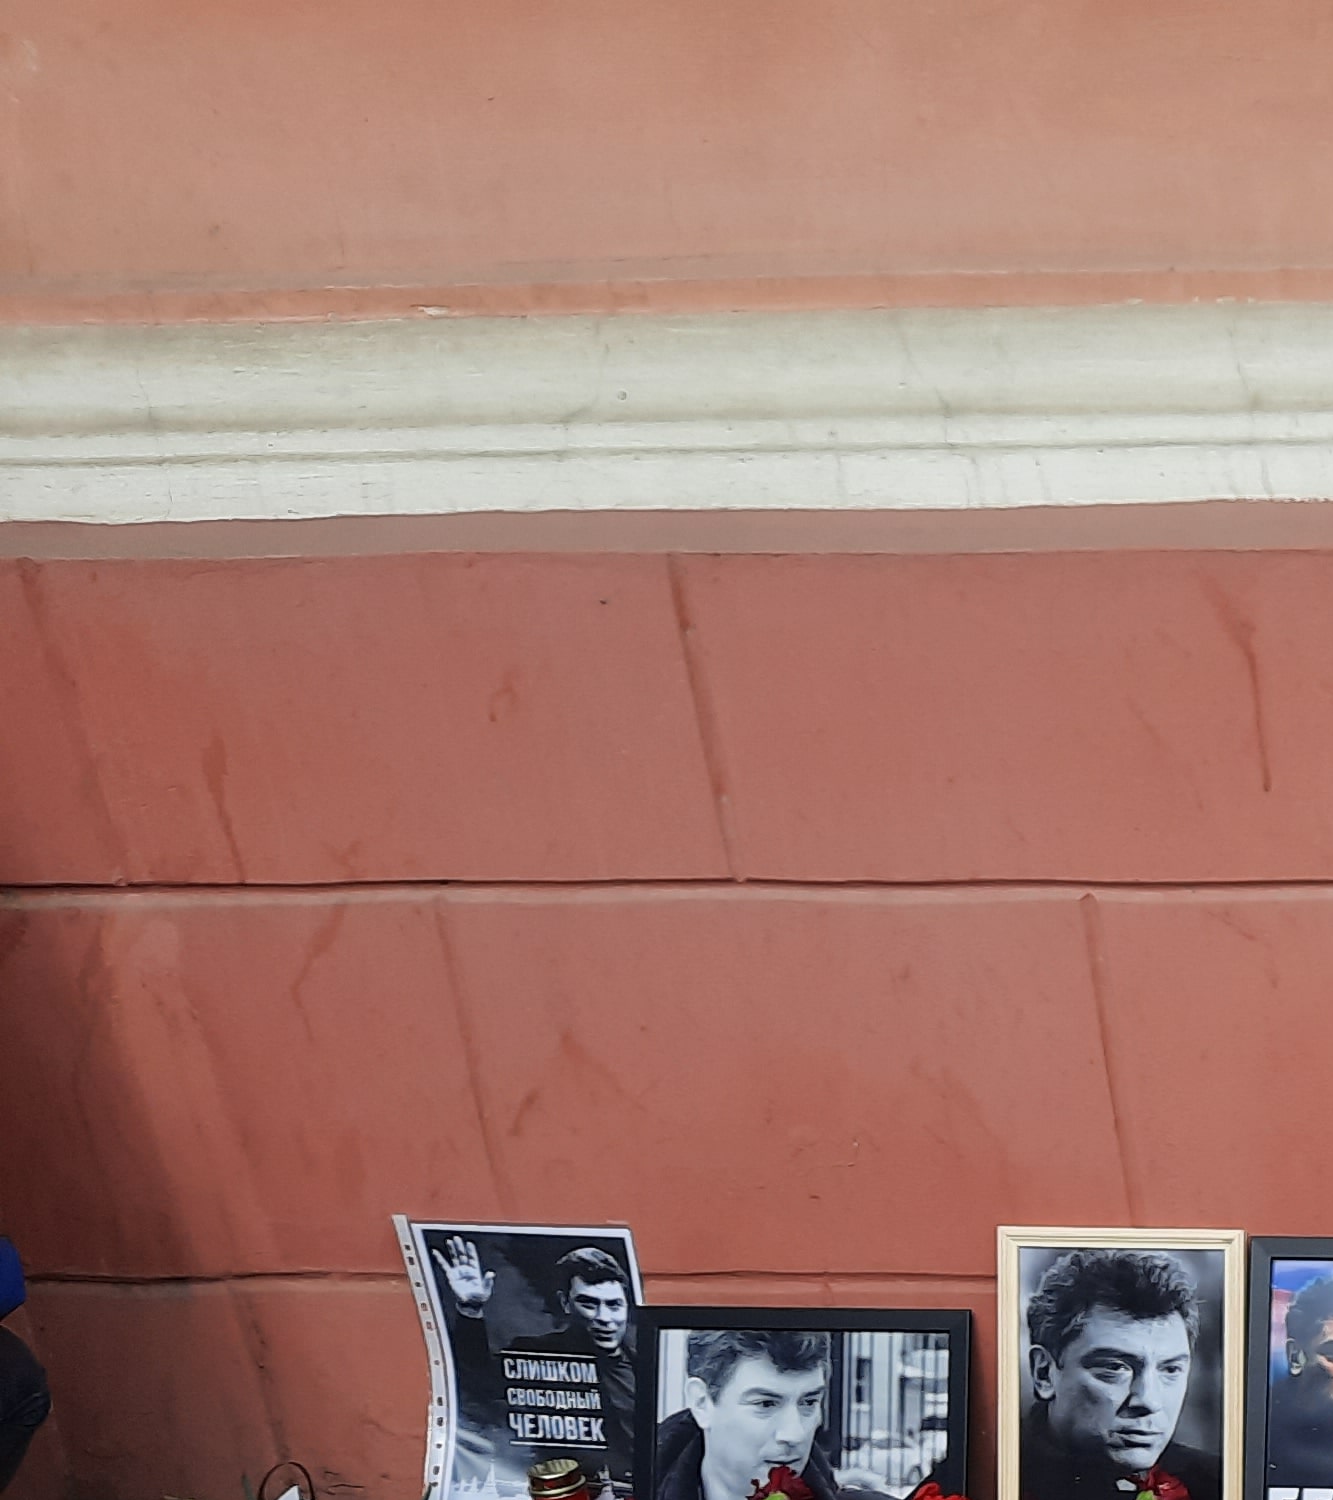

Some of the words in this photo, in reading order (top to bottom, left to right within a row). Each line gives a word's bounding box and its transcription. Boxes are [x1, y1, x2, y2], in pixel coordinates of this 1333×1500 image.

[503, 1358, 600, 1383] СЛИШКОМ
[506, 1387, 602, 1410] СВОБОДНЫЙ
[508, 1412, 607, 1441] ЧЕЛОВЕК
